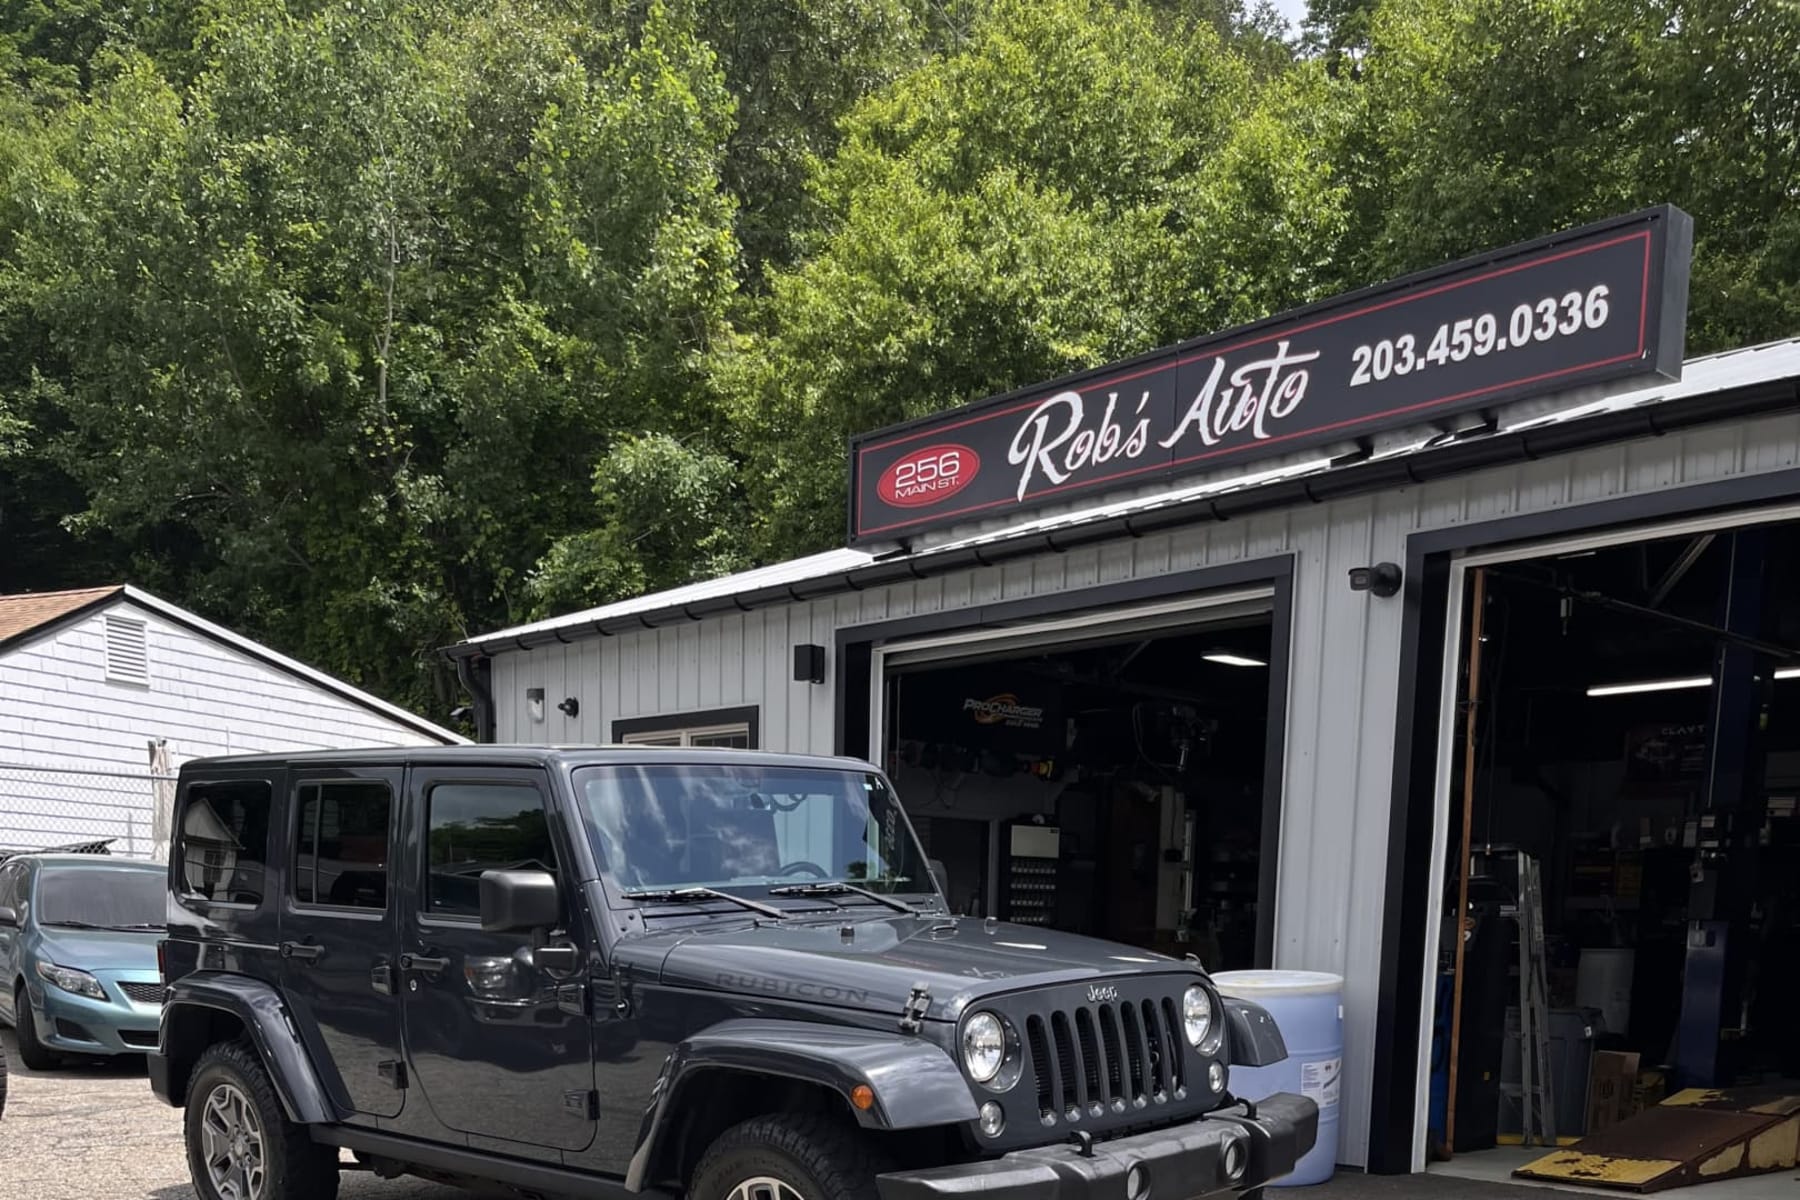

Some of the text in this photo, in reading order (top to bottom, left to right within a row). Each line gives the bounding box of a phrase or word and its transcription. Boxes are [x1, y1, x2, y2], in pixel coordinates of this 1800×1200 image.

[1349, 284, 1610, 387] 203.459.0336
[1007, 341, 1321, 502] Rob's Auto
[895, 451, 960, 489] 256
[895, 475, 960, 499] MAIN ST.
[715, 972, 869, 1003] RUBICON
[1086, 984, 1118, 1003] Jeep
